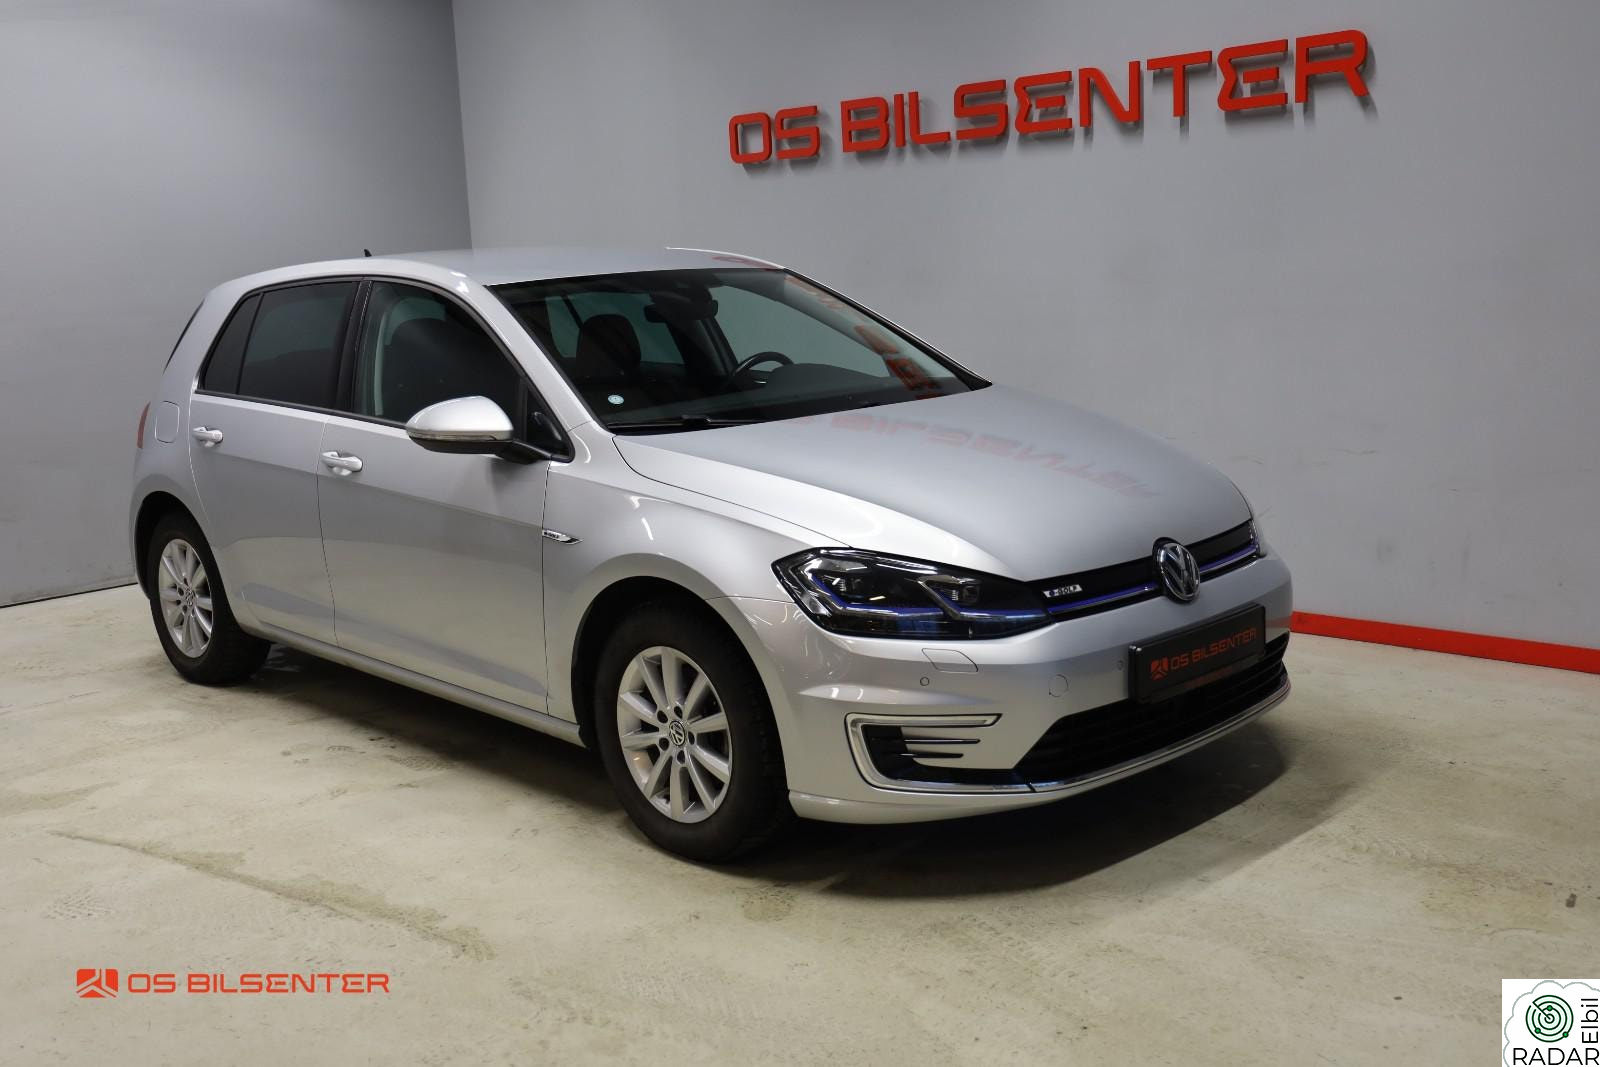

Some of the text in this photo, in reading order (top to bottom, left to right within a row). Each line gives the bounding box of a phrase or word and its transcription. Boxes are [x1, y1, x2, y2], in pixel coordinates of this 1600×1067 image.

[728, 29, 1371, 165] OS BILSENTER
[1170, 628, 1257, 670] OS BILSENTER
